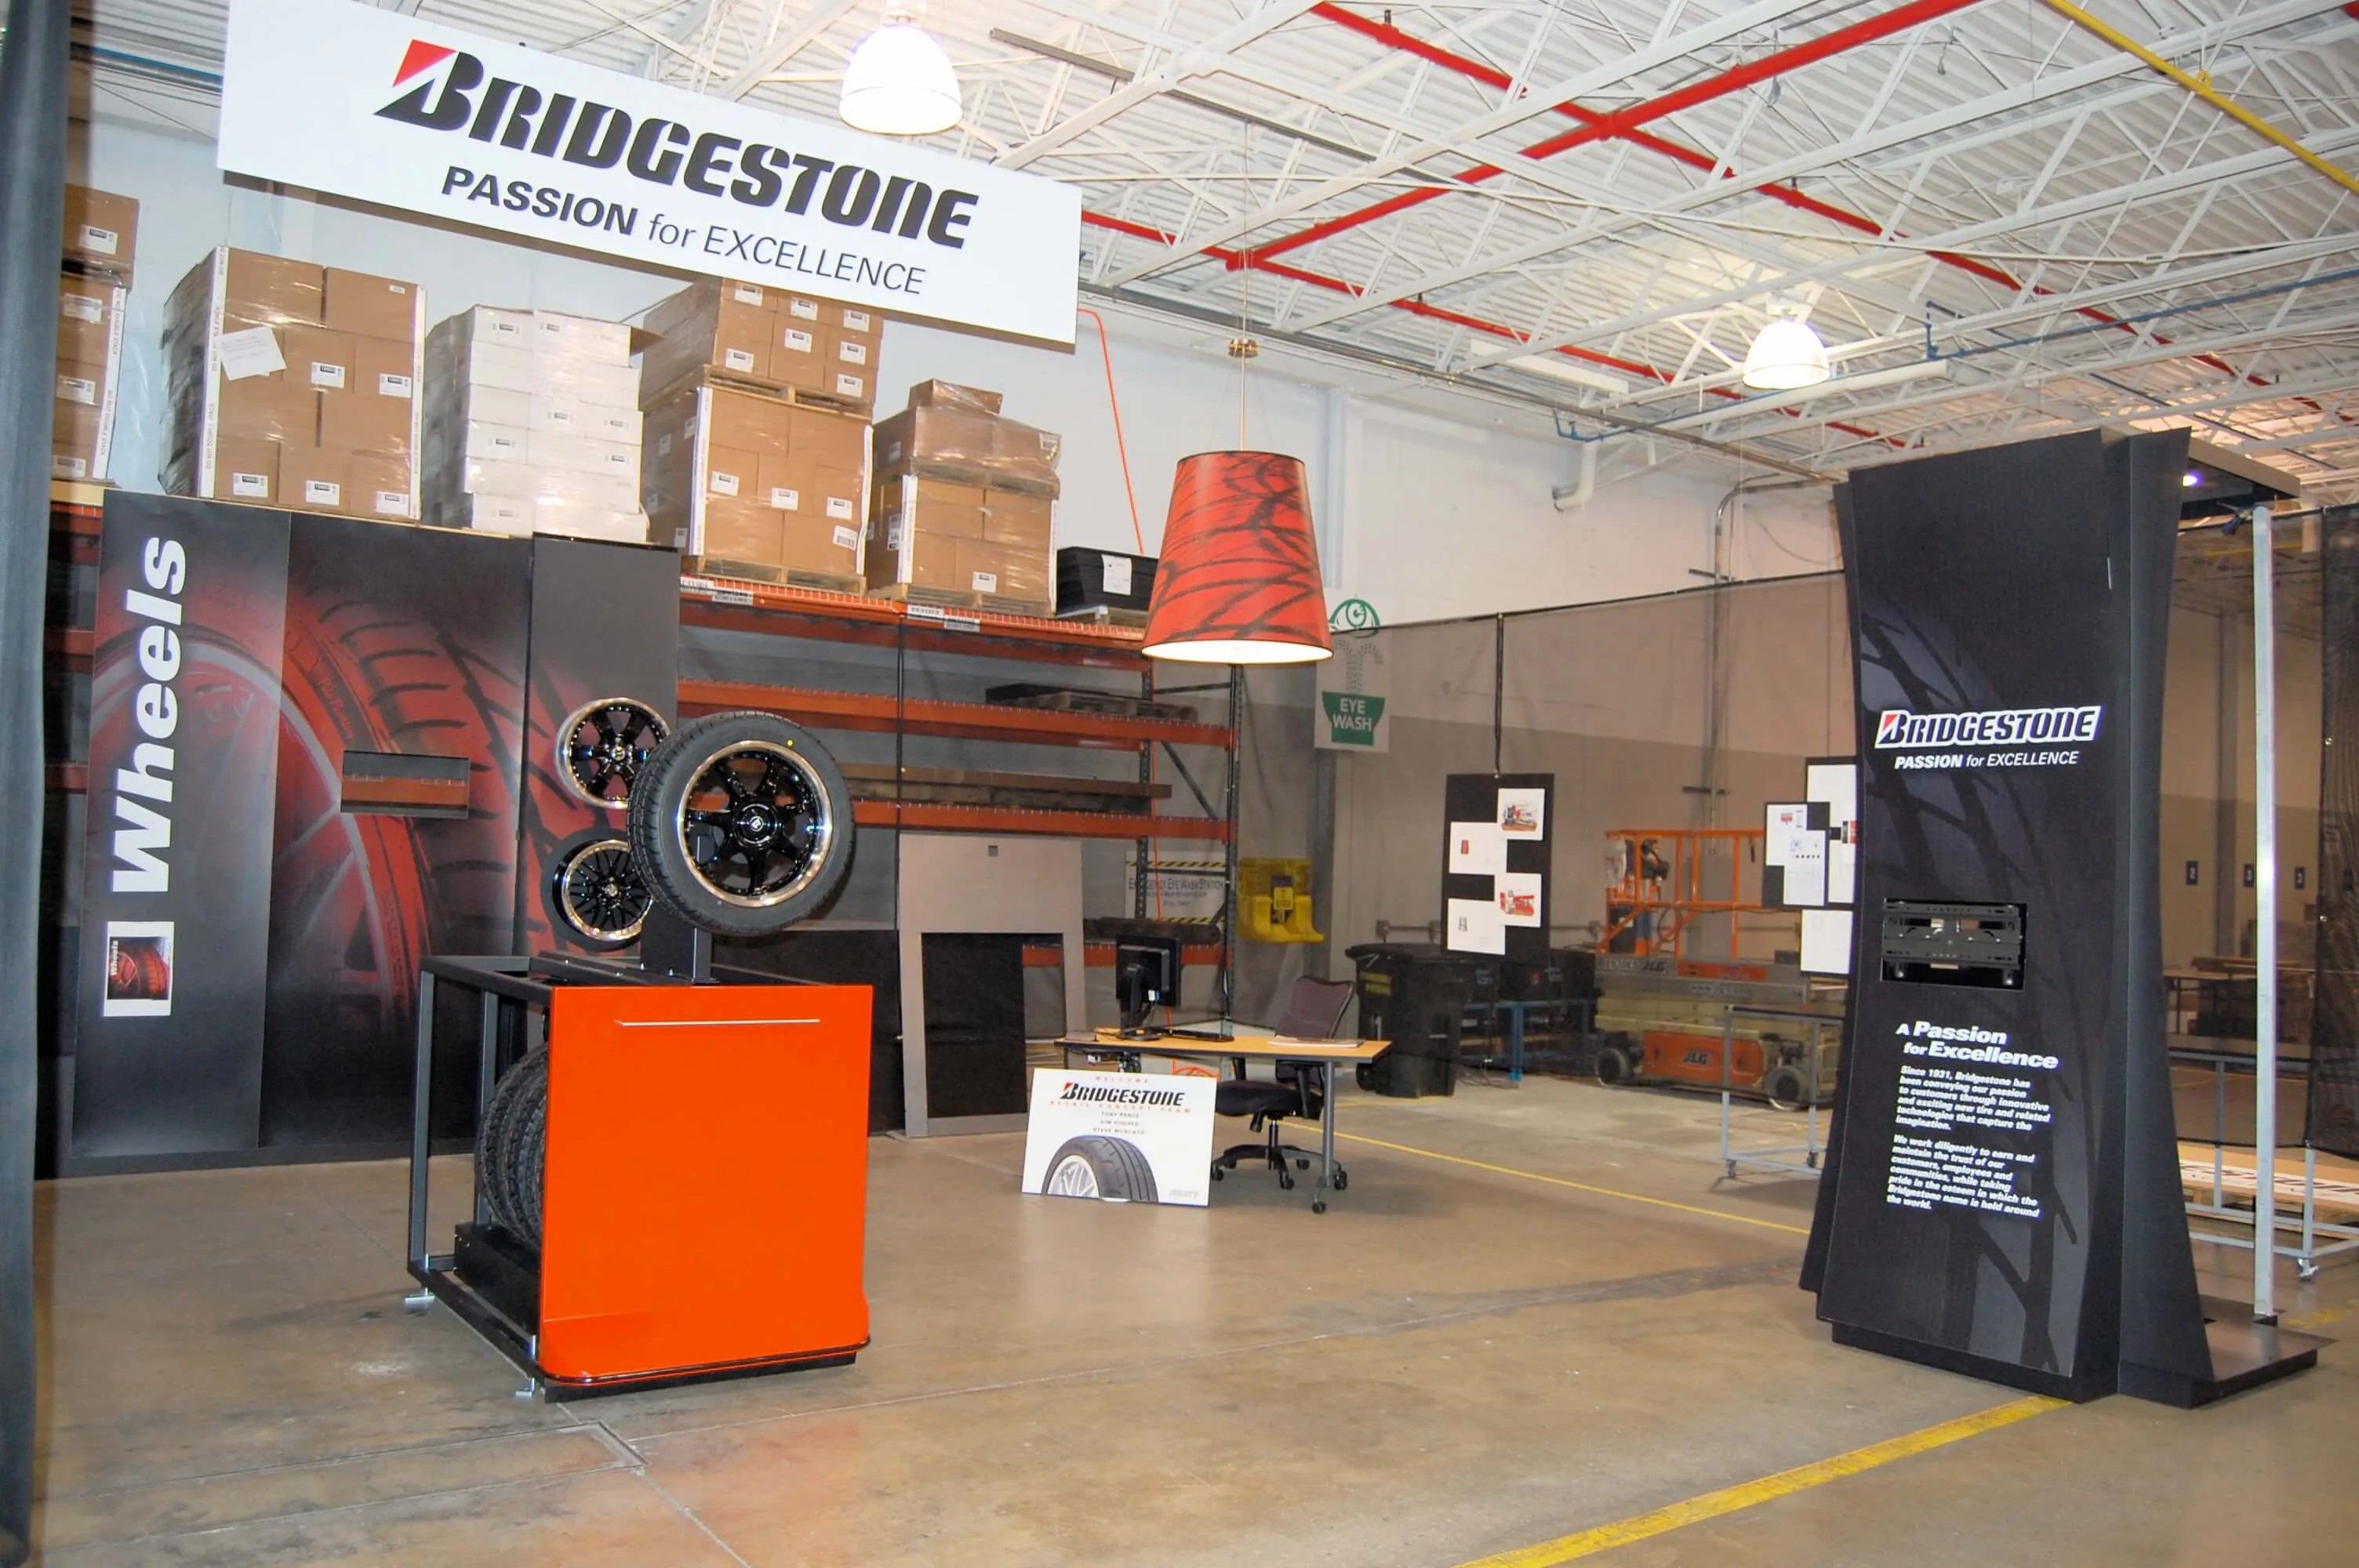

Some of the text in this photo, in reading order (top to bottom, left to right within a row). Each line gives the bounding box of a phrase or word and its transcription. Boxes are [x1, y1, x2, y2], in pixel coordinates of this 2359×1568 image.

[373, 38, 979, 249] BRIDGESTONE
[441, 165, 928, 296] PASSION for EXCELLENCE
[113, 537, 187, 893] Wheels
[1339, 698, 1365, 714] EYE
[1332, 714, 1372, 731] WASH
[1876, 707, 2099, 747] BRIDGESTONE
[1894, 751, 2079, 769] PASSION for EXCELLENCE
[110, 941, 118, 976] Wheels
[1896, 1021, 2007, 1044] A Passion
[1683, 1051, 1707, 1065] JLG
[1903, 1041, 2058, 1069] for Excellence
[1899, 1076, 1921, 1085] been
[1923, 1080, 1970, 1092] conveying
[1990, 1087, 2026, 1098] passion
[1901, 1065, 2030, 1088] Since 1931, Bridgestone has
[1060, 1082, 1186, 1106] BRIDGESTONE
[1910, 1088, 1958, 1100] customers
[1959, 1094, 1997, 1105] through
[1998, 1098, 2049, 1111] innovative
[1897, 1106, 2032, 1131] technologies that capture the
[1898, 1097, 2051, 1122] and exciting new tire and related
[1896, 1116, 1951, 1130] imagination.
[1892, 1146, 1932, 1158] maintain
[1933, 1151, 1949, 1160] the
[1951, 1154, 1974, 1163] trust
[1976, 1157, 1986, 1166] of
[1894, 1134, 1907, 1144] We
[1910, 1138, 1933, 1148] work
[1935, 1141, 1979, 1156] diligently
[1992, 1151, 2013, 1160] earn
[2015, 1154, 2036, 1163] and
[1890, 1166, 2012, 1192] communities, while taking
[1891, 1156, 2013, 1181] customers, employees and
[1887, 1195, 1932, 1209] the world.
[1888, 1176, 1912, 1186] pride
[1925, 1181, 1940, 1190] the
[1942, 1185, 1976, 1196] esteem
[1977, 1188, 1987, 1197] in
[1989, 1191, 2019, 1203] which
[2021, 1196, 2038, 1206] the
[1888, 1184, 2041, 1217] Bridgestone name is held around
